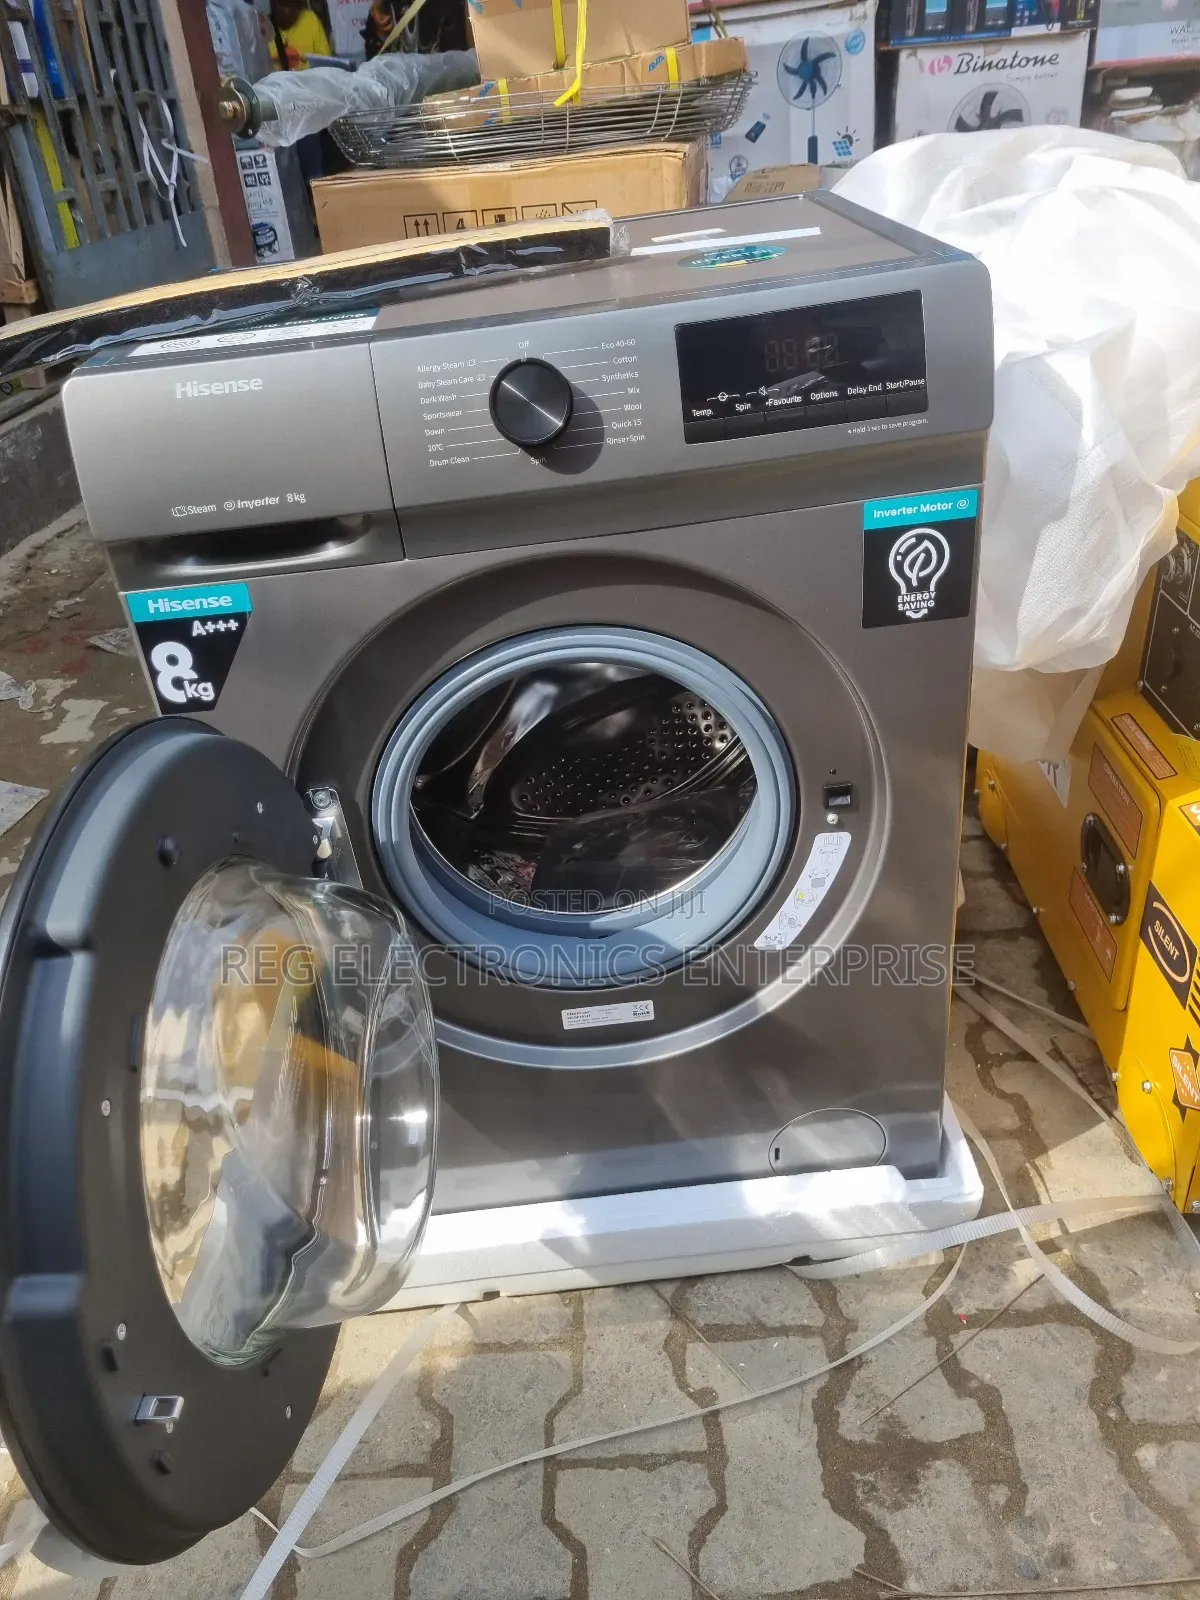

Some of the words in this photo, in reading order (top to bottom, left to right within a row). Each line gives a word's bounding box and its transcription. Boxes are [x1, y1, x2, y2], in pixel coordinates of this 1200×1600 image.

[954, 51, 1060, 75] Binatone
[518, 341, 530, 350] Off
[601, 341, 615, 350] Eco
[616, 338, 636, 347] 40-60
[612, 355, 638, 364] Cotton
[417, 363, 441, 373] Allergy
[442, 360, 465, 370] Steam
[418, 380, 436, 390] Baby
[436, 377, 458, 387] Steam
[458, 375, 475, 384] Care
[601, 370, 639, 383] Synthetics
[175, 378, 263, 399] Hisense
[847, 386, 868, 396] Delay
[868, 383, 882, 392] End
[886, 378, 926, 390] Start/Pause
[627, 386, 641, 395] Mix
[810, 390, 839, 401] Options
[420, 395, 438, 405] Dark
[438, 392, 457, 402] Wash
[623, 401, 642, 412] Wool
[735, 402, 751, 412] Spin
[422, 409, 463, 421] Sportswear
[691, 409, 714, 418] Temp.
[611, 419, 632, 430] Quick
[852, 426, 866, 434] Hold
[881, 422, 888, 430] to
[888, 421, 902, 430] save
[902, 418, 929, 428] program.
[424, 428, 445, 437] Down
[429, 458, 449, 468] Drum
[450, 455, 470, 465] Clean
[530, 456, 547, 465] Spin
[187, 502, 217, 516] Steam
[873, 506, 919, 519] Inverter
[920, 501, 954, 512] Motor
[897, 591, 936, 603] ENERGY
[147, 595, 233, 614] Hisense
[897, 600, 935, 611] SAVING
[192, 618, 239, 637] A+++
[1153, 920, 1180, 961] SILENT
[1171, 1054, 1200, 1104] SILENT
